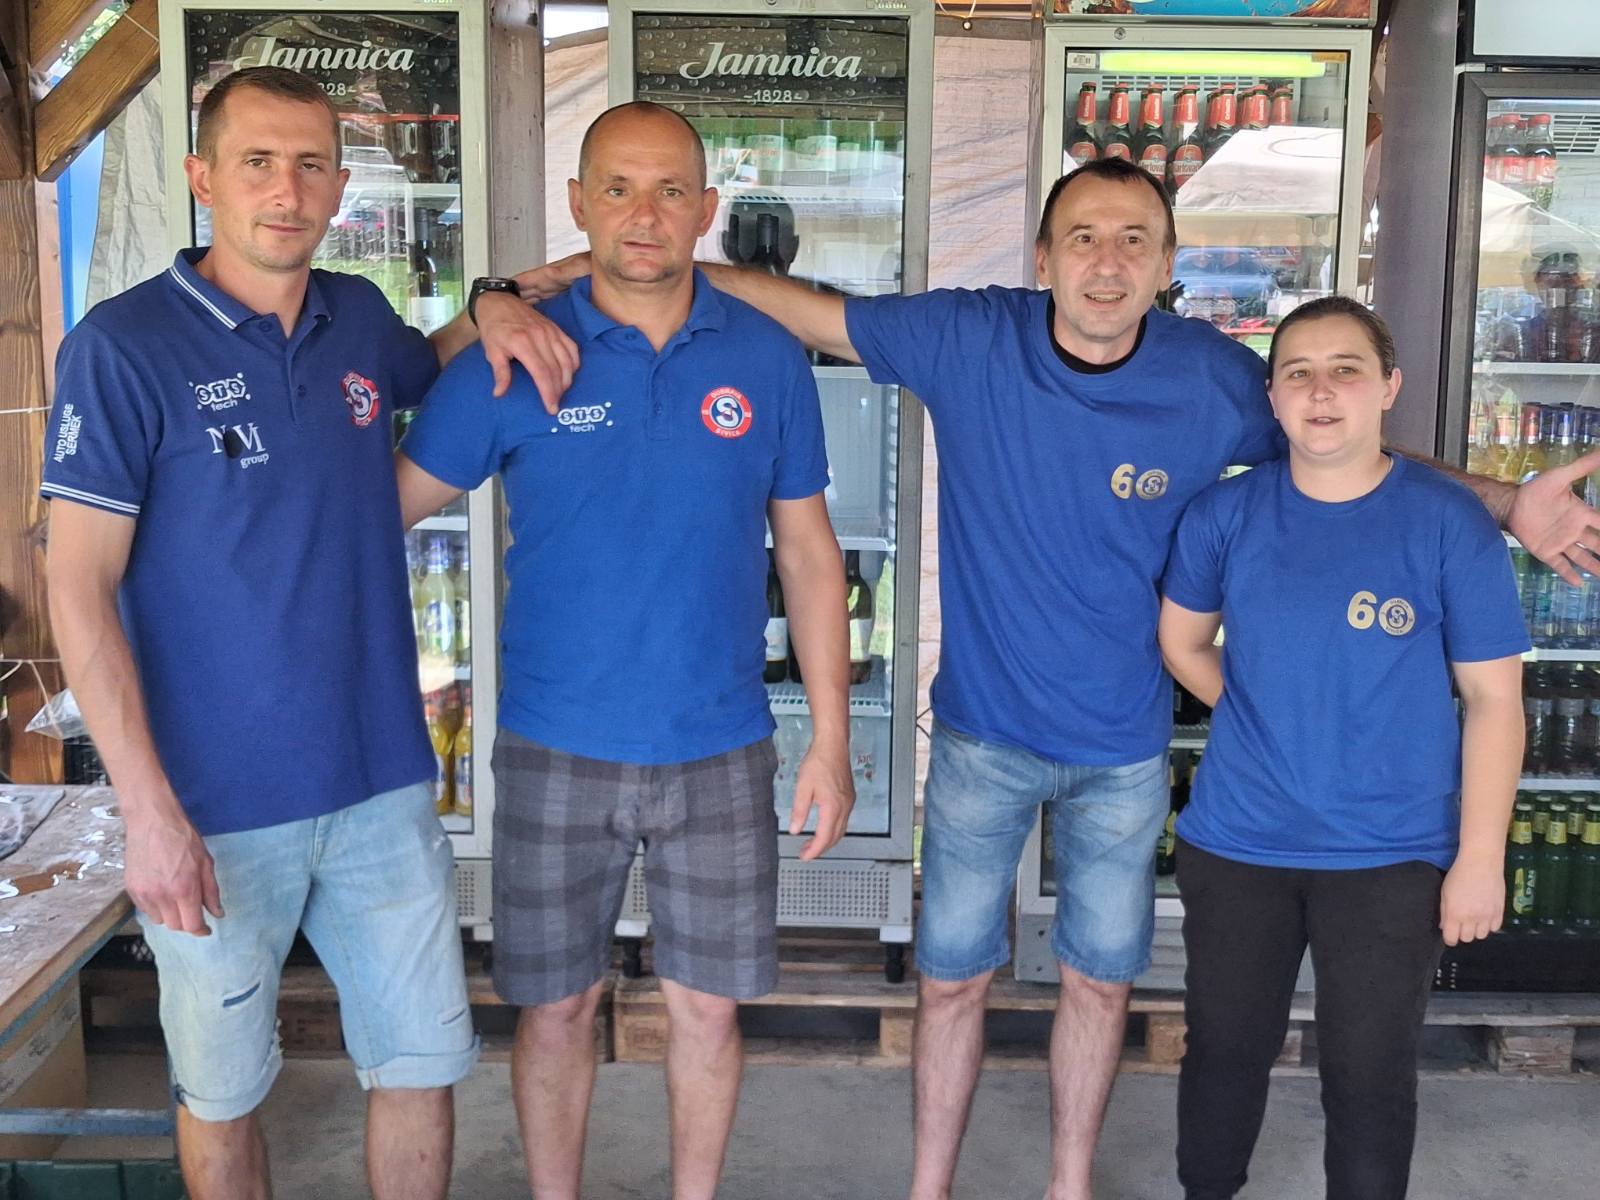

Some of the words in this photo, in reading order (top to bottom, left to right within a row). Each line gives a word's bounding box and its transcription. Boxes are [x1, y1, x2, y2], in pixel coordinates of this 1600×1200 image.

[232, 36, 415, 71] Jamnica
[679, 42, 862, 80] Jamnica
[196, 379, 244, 404] STS
[211, 399, 238, 411] tech
[559, 407, 604, 424] STS
[57, 403, 74, 438] USLUGE
[569, 423, 595, 433] tech
[65, 414, 83, 456] SERMEK
[53, 438, 67, 463] AUTO
[240, 453, 269, 469] group
